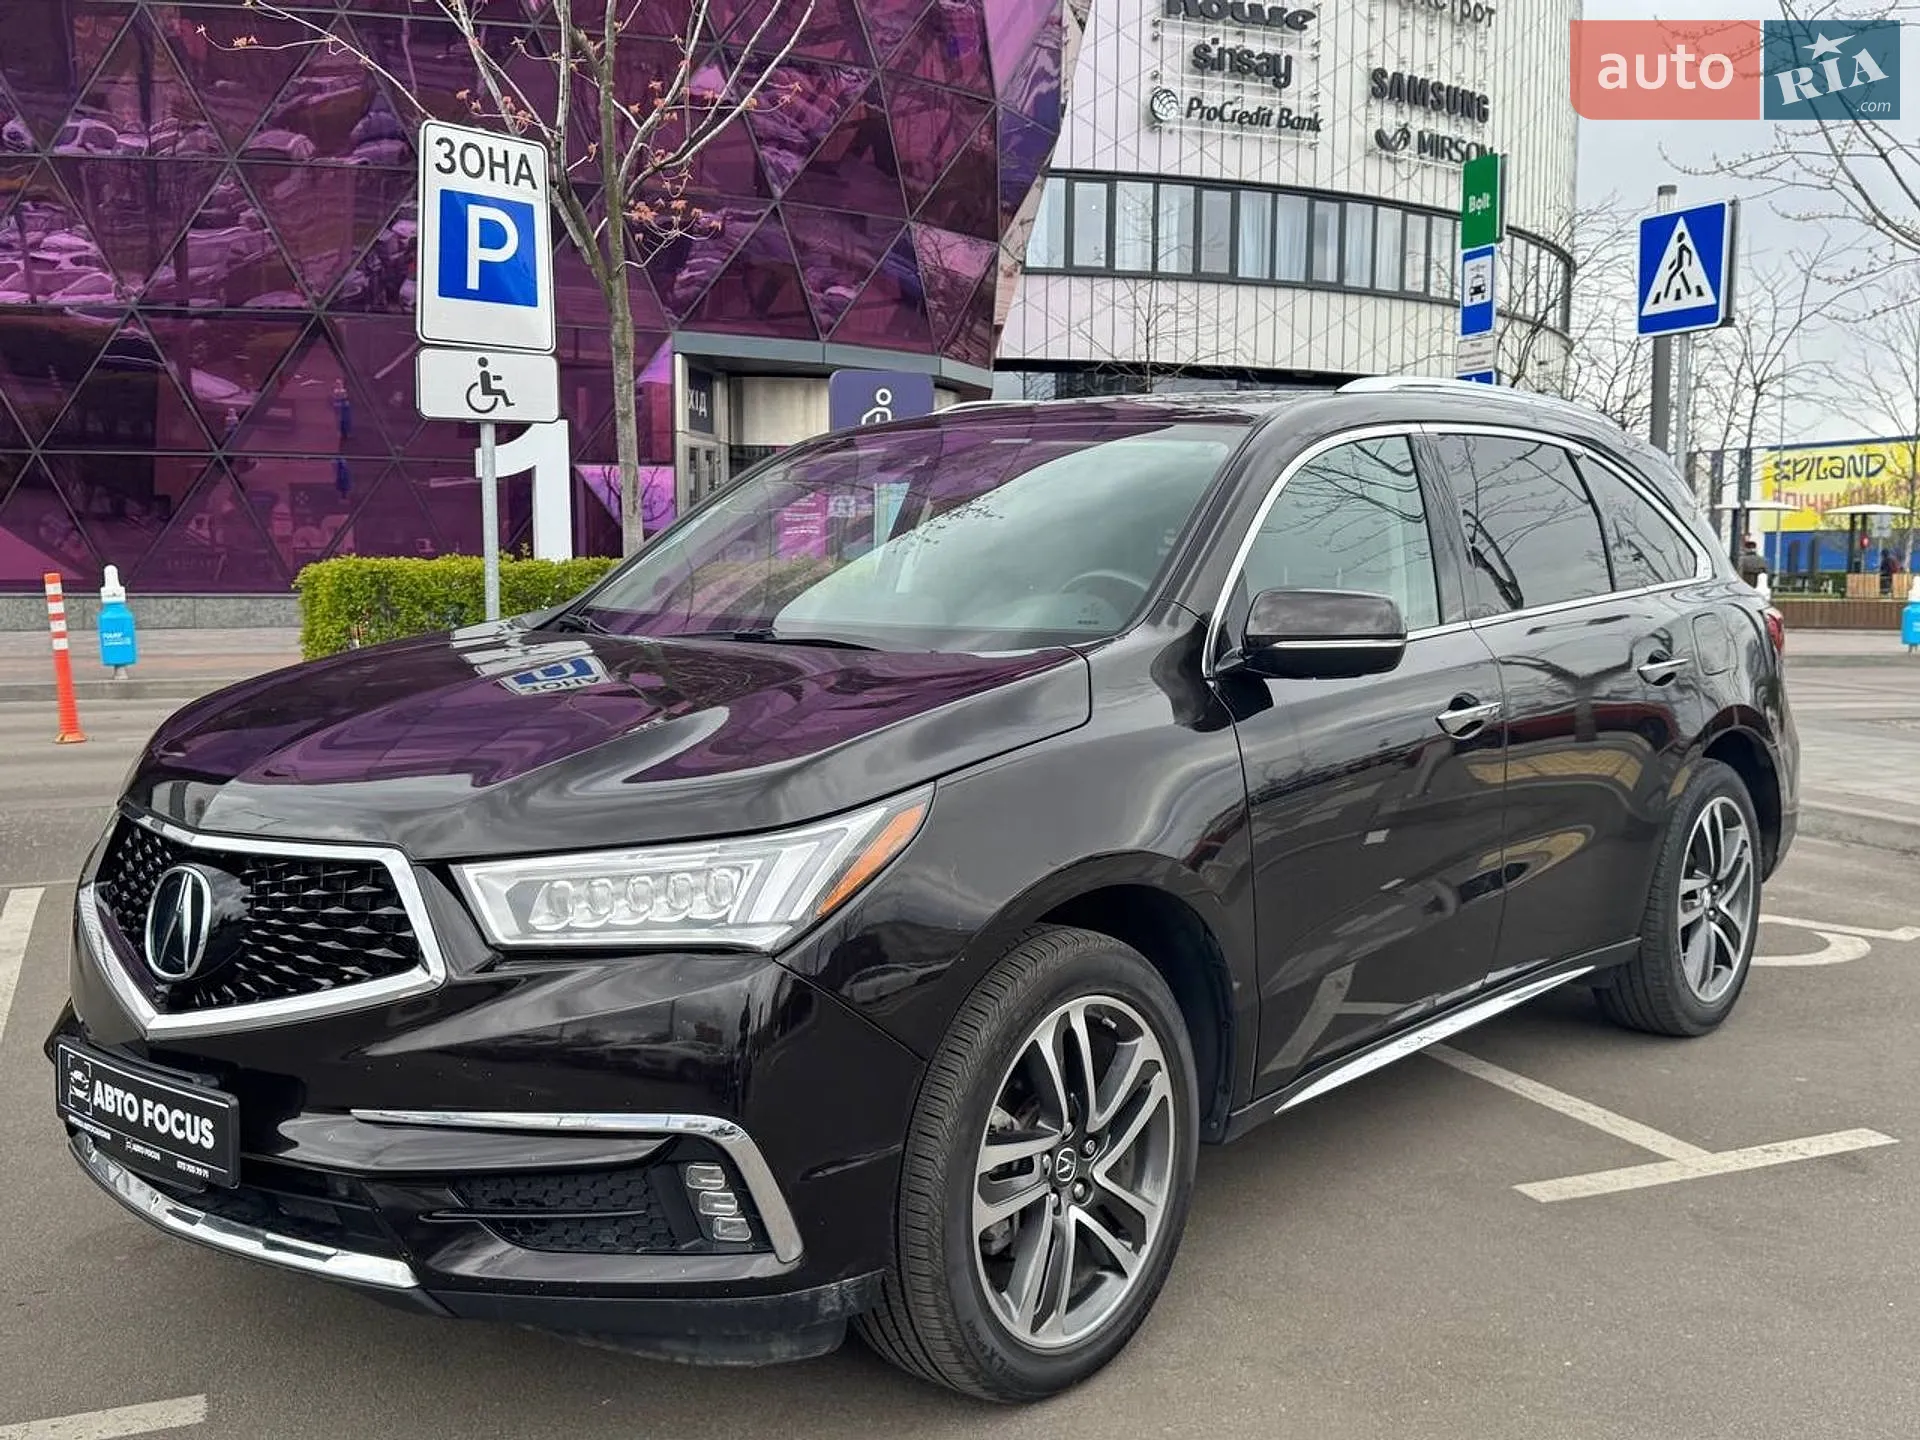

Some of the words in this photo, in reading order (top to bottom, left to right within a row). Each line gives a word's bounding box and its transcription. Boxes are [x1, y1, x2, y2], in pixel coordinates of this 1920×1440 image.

[1192, 38, 1293, 88] sinsay
[1186, 97, 1274, 127] ProCredit
[1277, 108, 1323, 133] Bank
[1371, 67, 1489, 123] SAMSUNG
[434, 137, 538, 191] ЗОНА
[1468, 193, 1491, 215] Bolt
[142, 1098, 215, 1150] FOCUS
